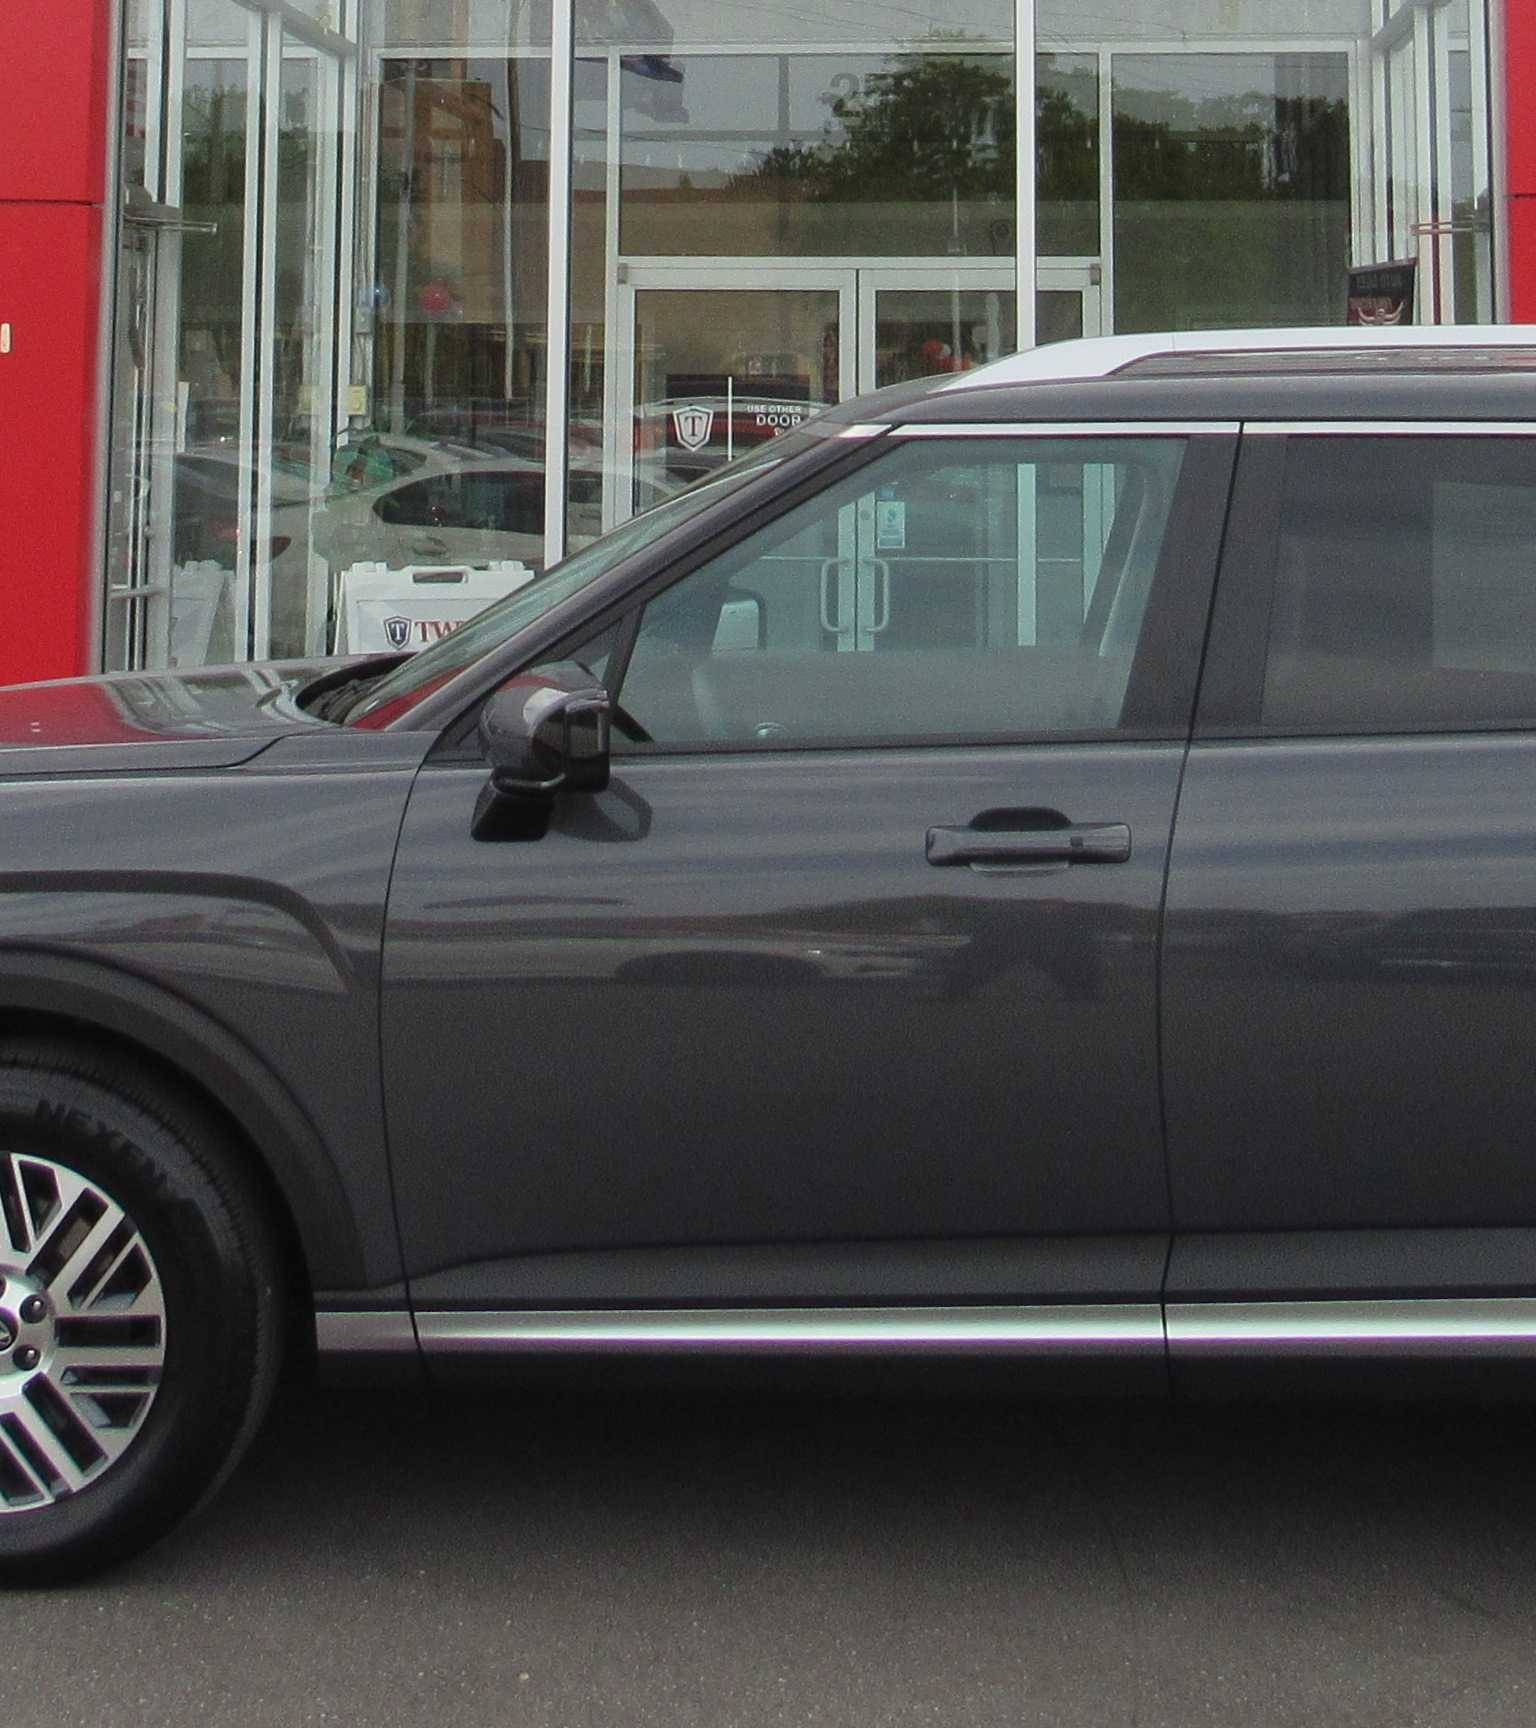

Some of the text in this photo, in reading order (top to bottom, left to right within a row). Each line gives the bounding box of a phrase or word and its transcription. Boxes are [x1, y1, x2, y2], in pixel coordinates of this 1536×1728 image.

[747, 405, 802, 414] USE OTHER
[685, 416, 703, 437] T
[756, 414, 801, 426] DOOR
[390, 622, 404, 641] T
